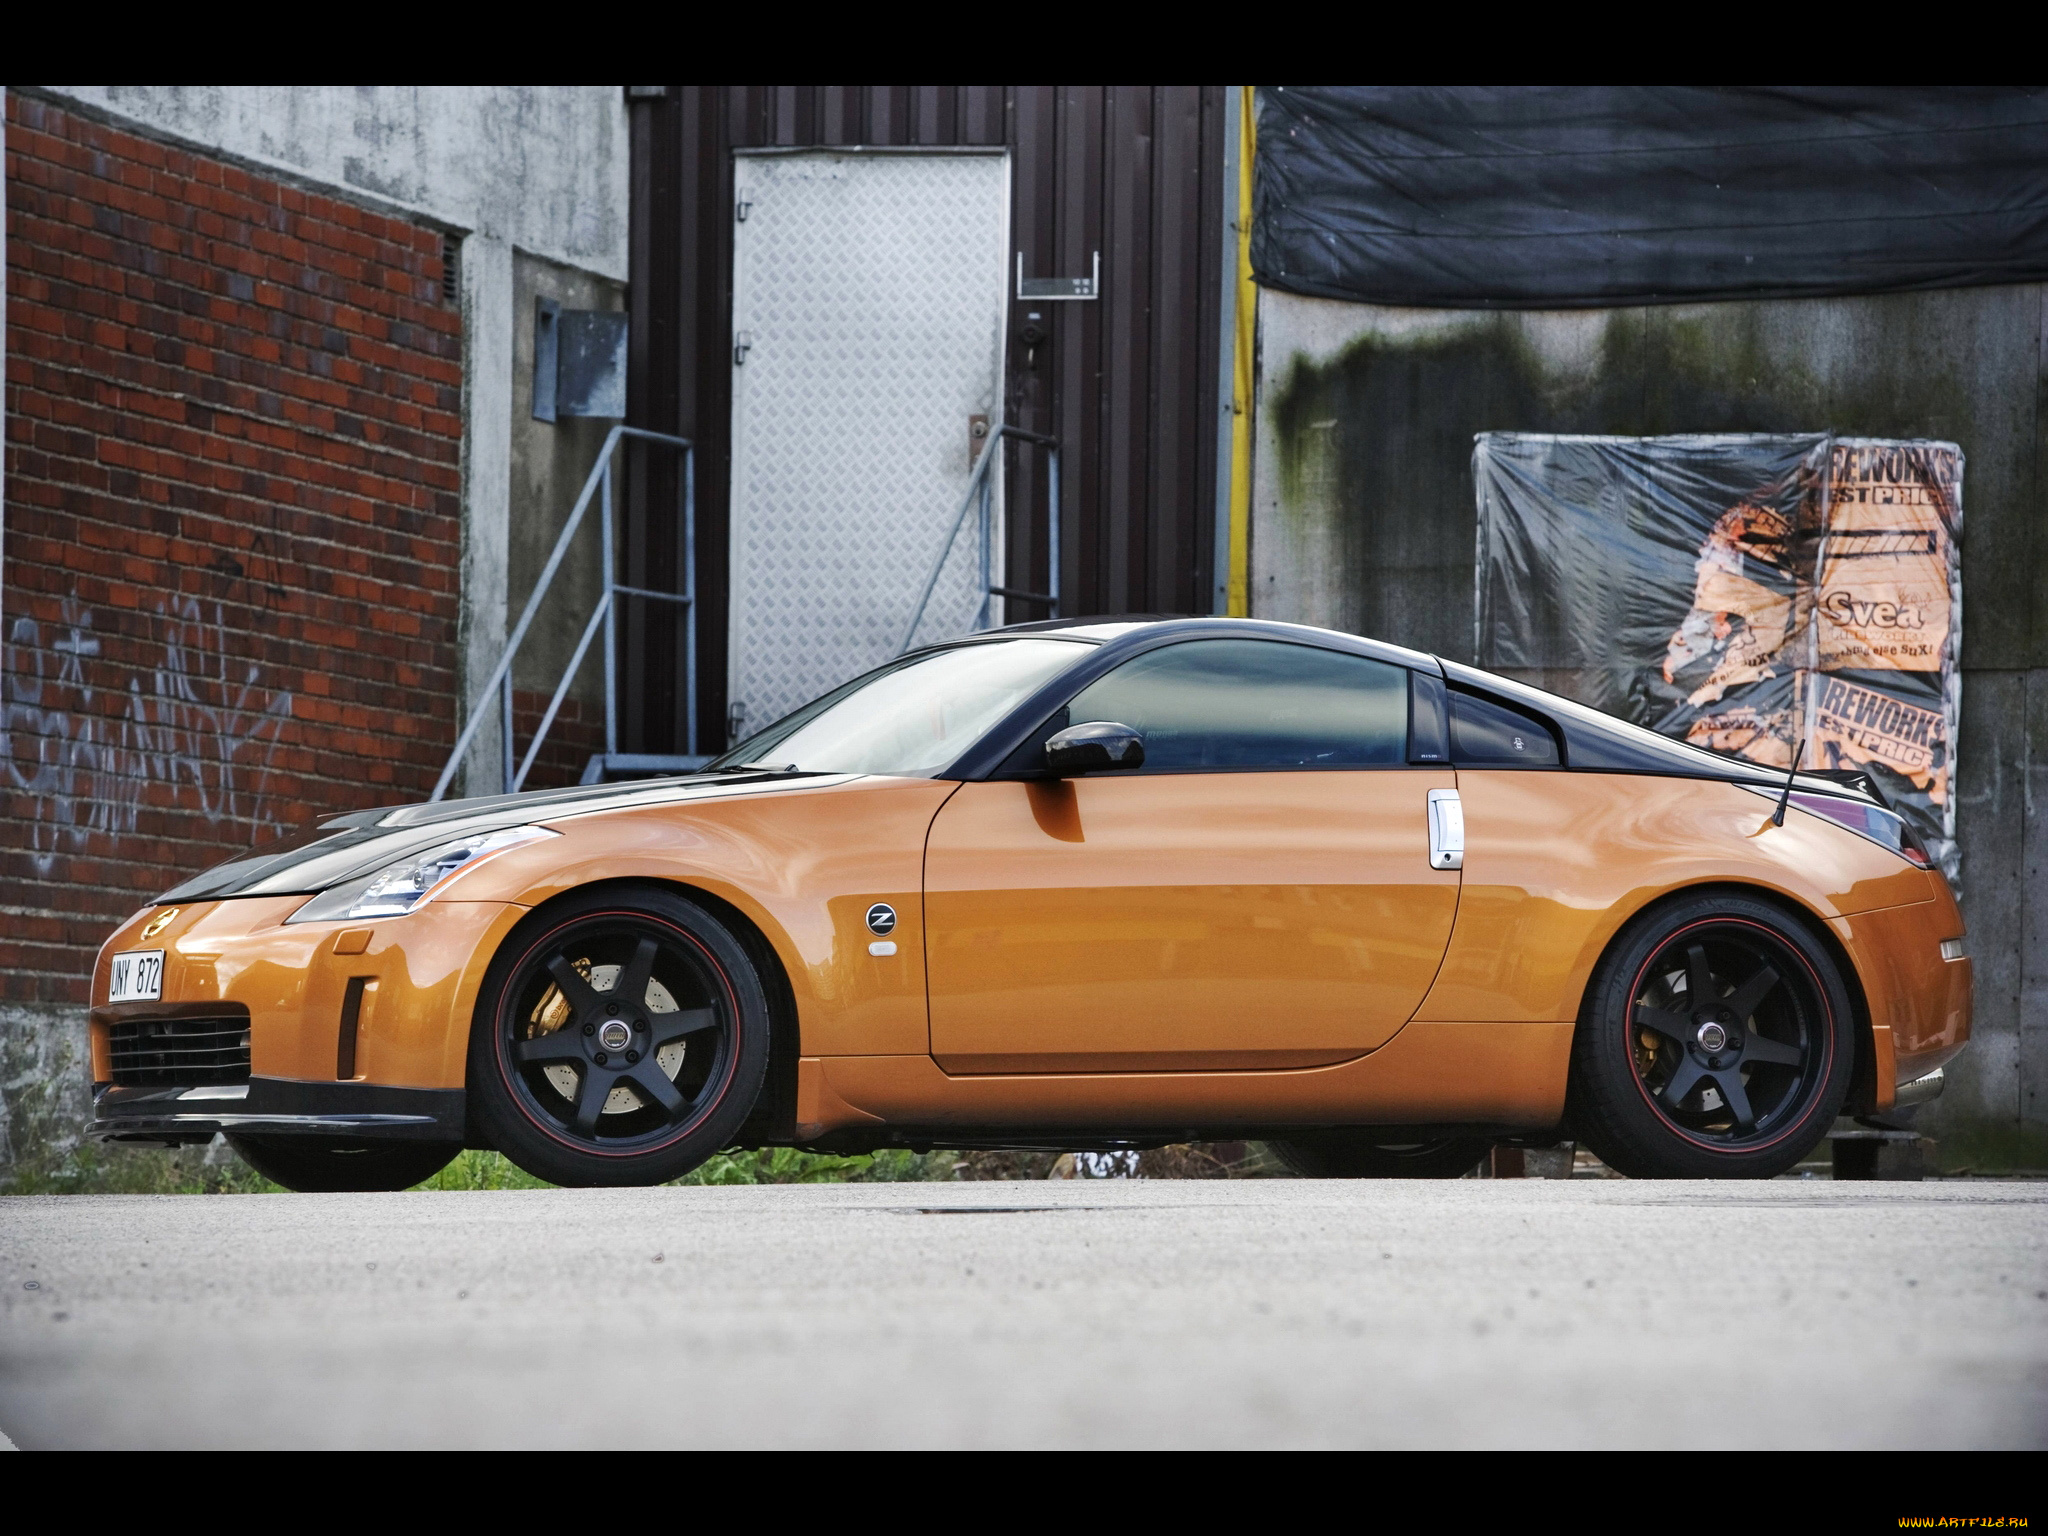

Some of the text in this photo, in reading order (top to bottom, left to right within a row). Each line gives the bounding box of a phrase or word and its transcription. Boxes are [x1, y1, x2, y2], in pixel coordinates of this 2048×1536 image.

[1818, 591, 1925, 629] Svea
[871, 912, 894, 927] Z
[111, 957, 160, 996] UNY 872
